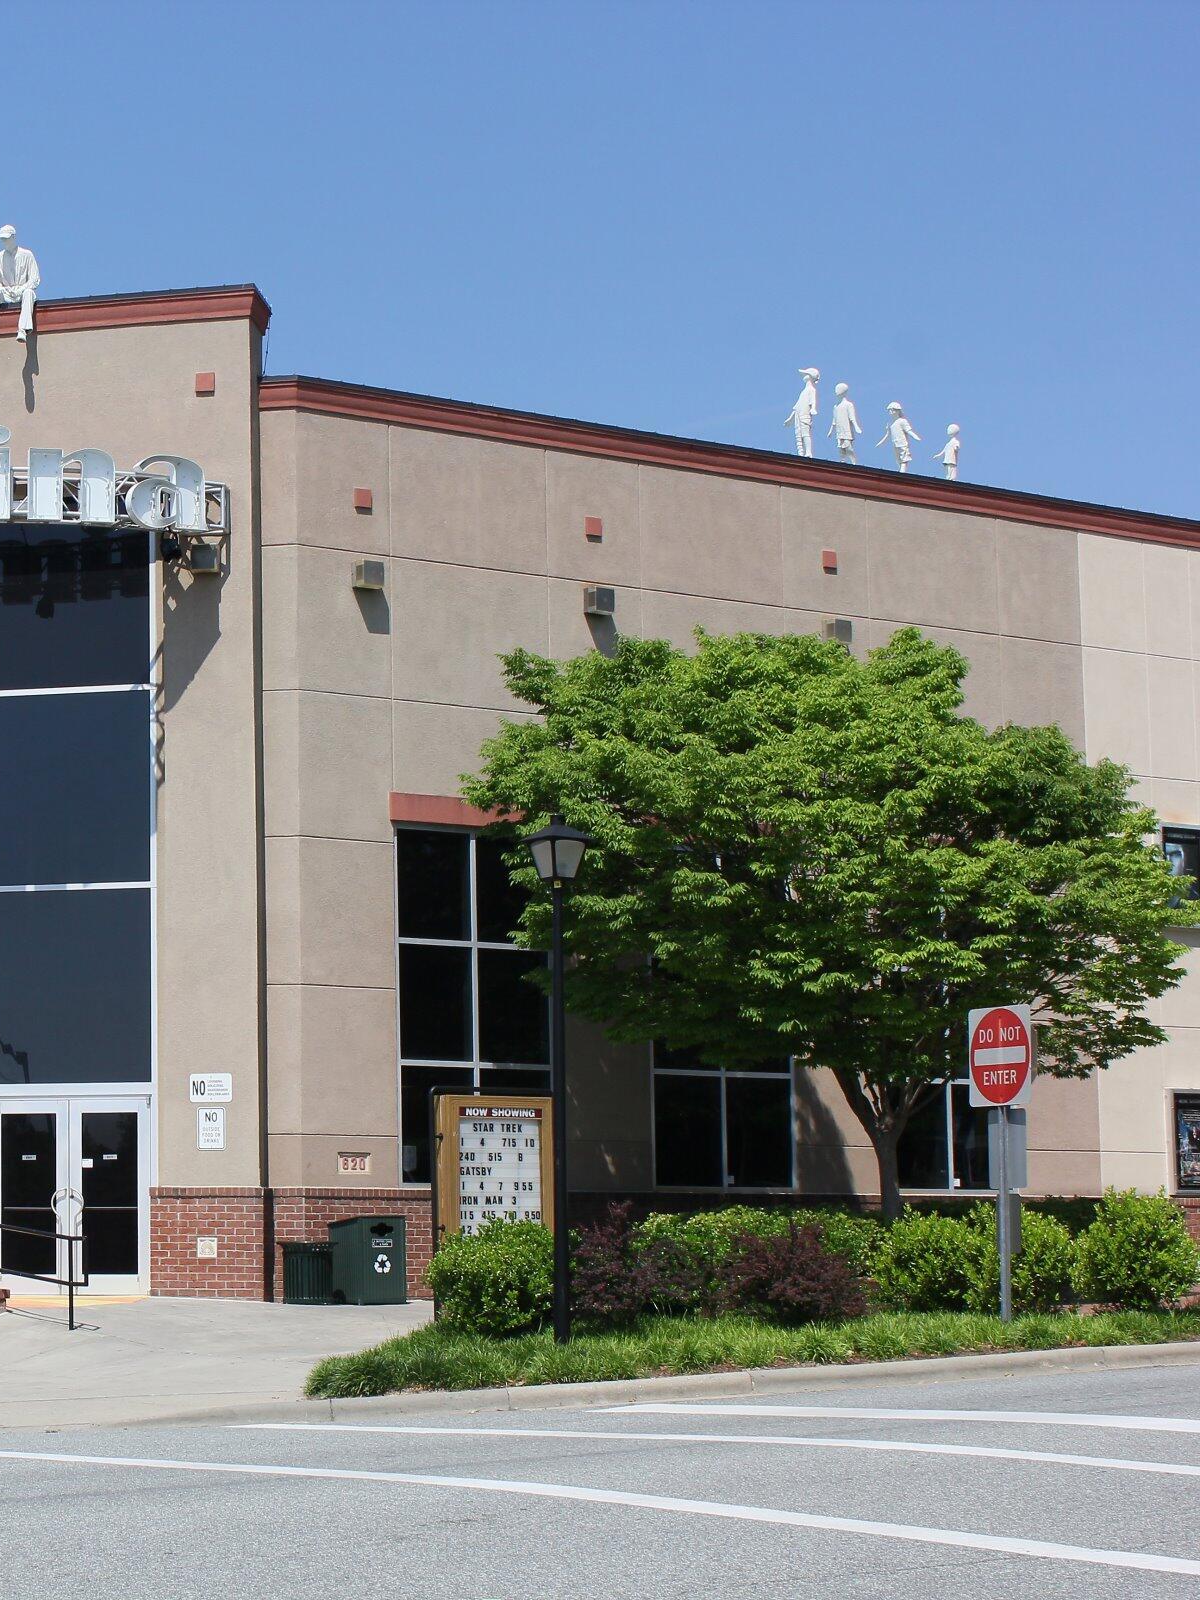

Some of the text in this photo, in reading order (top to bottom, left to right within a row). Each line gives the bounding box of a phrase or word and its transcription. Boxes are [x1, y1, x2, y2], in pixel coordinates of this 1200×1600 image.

[979, 1026, 1021, 1043] DO NOT
[983, 1070, 1017, 1085] ENTER
[192, 1080, 206, 1096] NO
[204, 1111, 218, 1122] NO
[465, 1107, 536, 1118] NOW SHOWING
[473, 1122, 523, 1133] STAR TREK
[480, 1137, 485, 1147] 4
[501, 1138, 517, 1147] 715
[459, 1152, 475, 1161] 240
[488, 1152, 502, 1162] 515
[460, 1166, 492, 1176] GATSBY
[479, 1181, 484, 1191] 4
[498, 1181, 503, 1190] 7
[459, 1196, 517, 1205] IRON MAN 3
[503, 1210, 517, 1220] 70
[524, 1210, 540, 1220] 950
